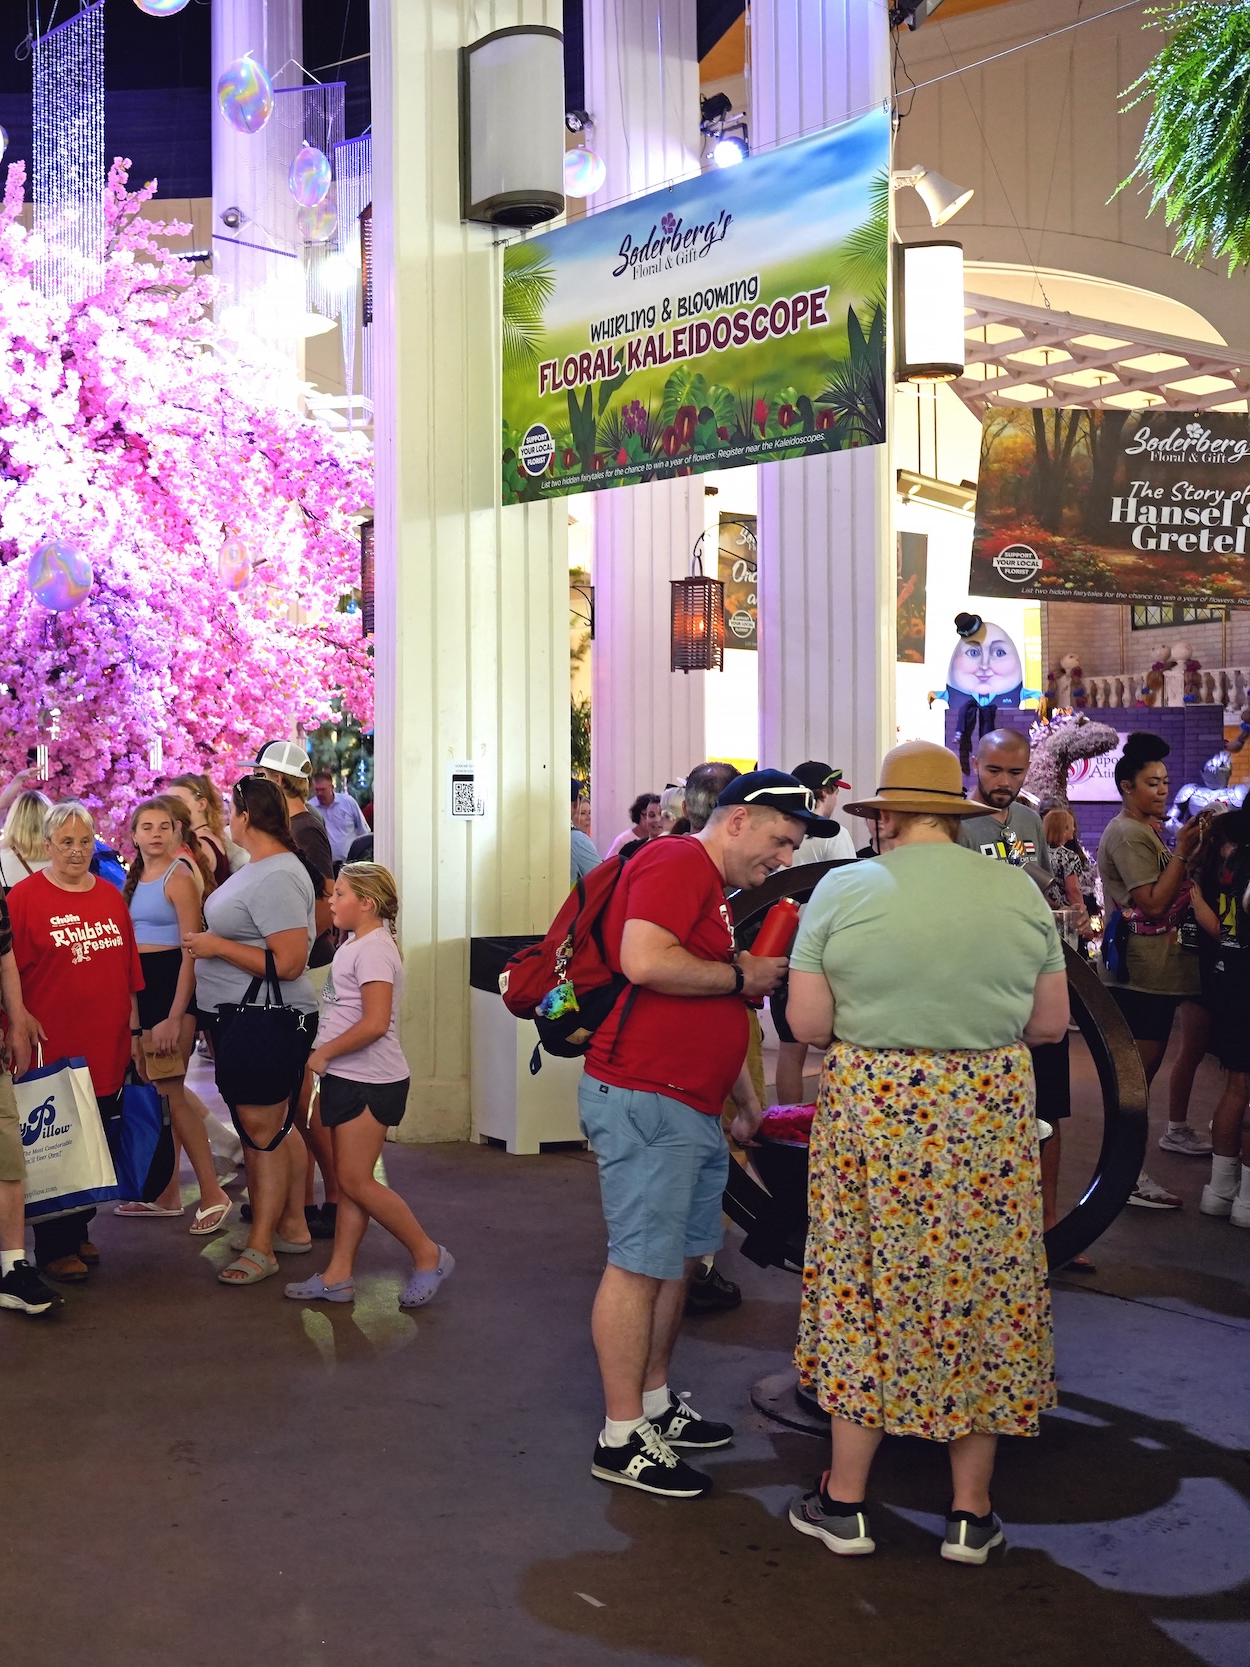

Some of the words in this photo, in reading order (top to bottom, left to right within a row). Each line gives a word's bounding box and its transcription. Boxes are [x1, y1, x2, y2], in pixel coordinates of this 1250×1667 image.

[612, 210, 734, 278] Soderberg's
[632, 260, 662, 281] Floral
[665, 256, 673, 269] &
[676, 248, 698, 266] Gift
[661, 298, 672, 316] &
[539, 348, 620, 394] FLORAL
[627, 288, 829, 371] KALEIDOSCOPE
[521, 446, 536, 456] YOUR
[536, 443, 553, 453] LOCAL
[526, 433, 547, 444] SUPPORT
[1125, 426, 1250, 463] Soderberg
[527, 456, 546, 466] FLORIST
[541, 481, 550, 489] List
[551, 479, 562, 488] two
[562, 475, 580, 487] hidden
[581, 471, 605, 485] fairytales
[605, 469, 614, 478] for
[614, 468, 624, 476] the
[624, 464, 646, 475] chance
[646, 463, 653, 471] to
[653, 461, 665, 470] win
[670, 458, 684, 468] year
[684, 455, 692, 464] of
[692, 452, 716, 463] flowers.
[718, 447, 746, 459] Register
[745, 444, 761, 453] near
[761, 442, 774, 451] the
[774, 432, 825, 449] Kaleidoscopes.
[1150, 451, 1186, 463] Floral
[1188, 453, 1199, 463] &
[1201, 452, 1226, 464] Gift
[1130, 481, 1165, 499] The
[1170, 481, 1226, 507] Story
[1230, 485, 1250, 505] of
[1109, 497, 1234, 527] Hansel
[1131, 523, 1247, 555] Gretel
[732, 560, 757, 583] Onc
[1049, 588, 1072, 596] hidden
[1073, 590, 1103, 598] fairytales
[1128, 592, 1153, 600] chance
[1200, 595, 1208, 603] of
[1237, 597, 1250, 606] Reg
[1096, 757, 1119, 768] upo
[49, 917, 121, 948] Rhubarb
[82, 935, 124, 955] Festival
[32, 1146, 44, 1155] Most
[44, 1139, 73, 1152] Comfortable
